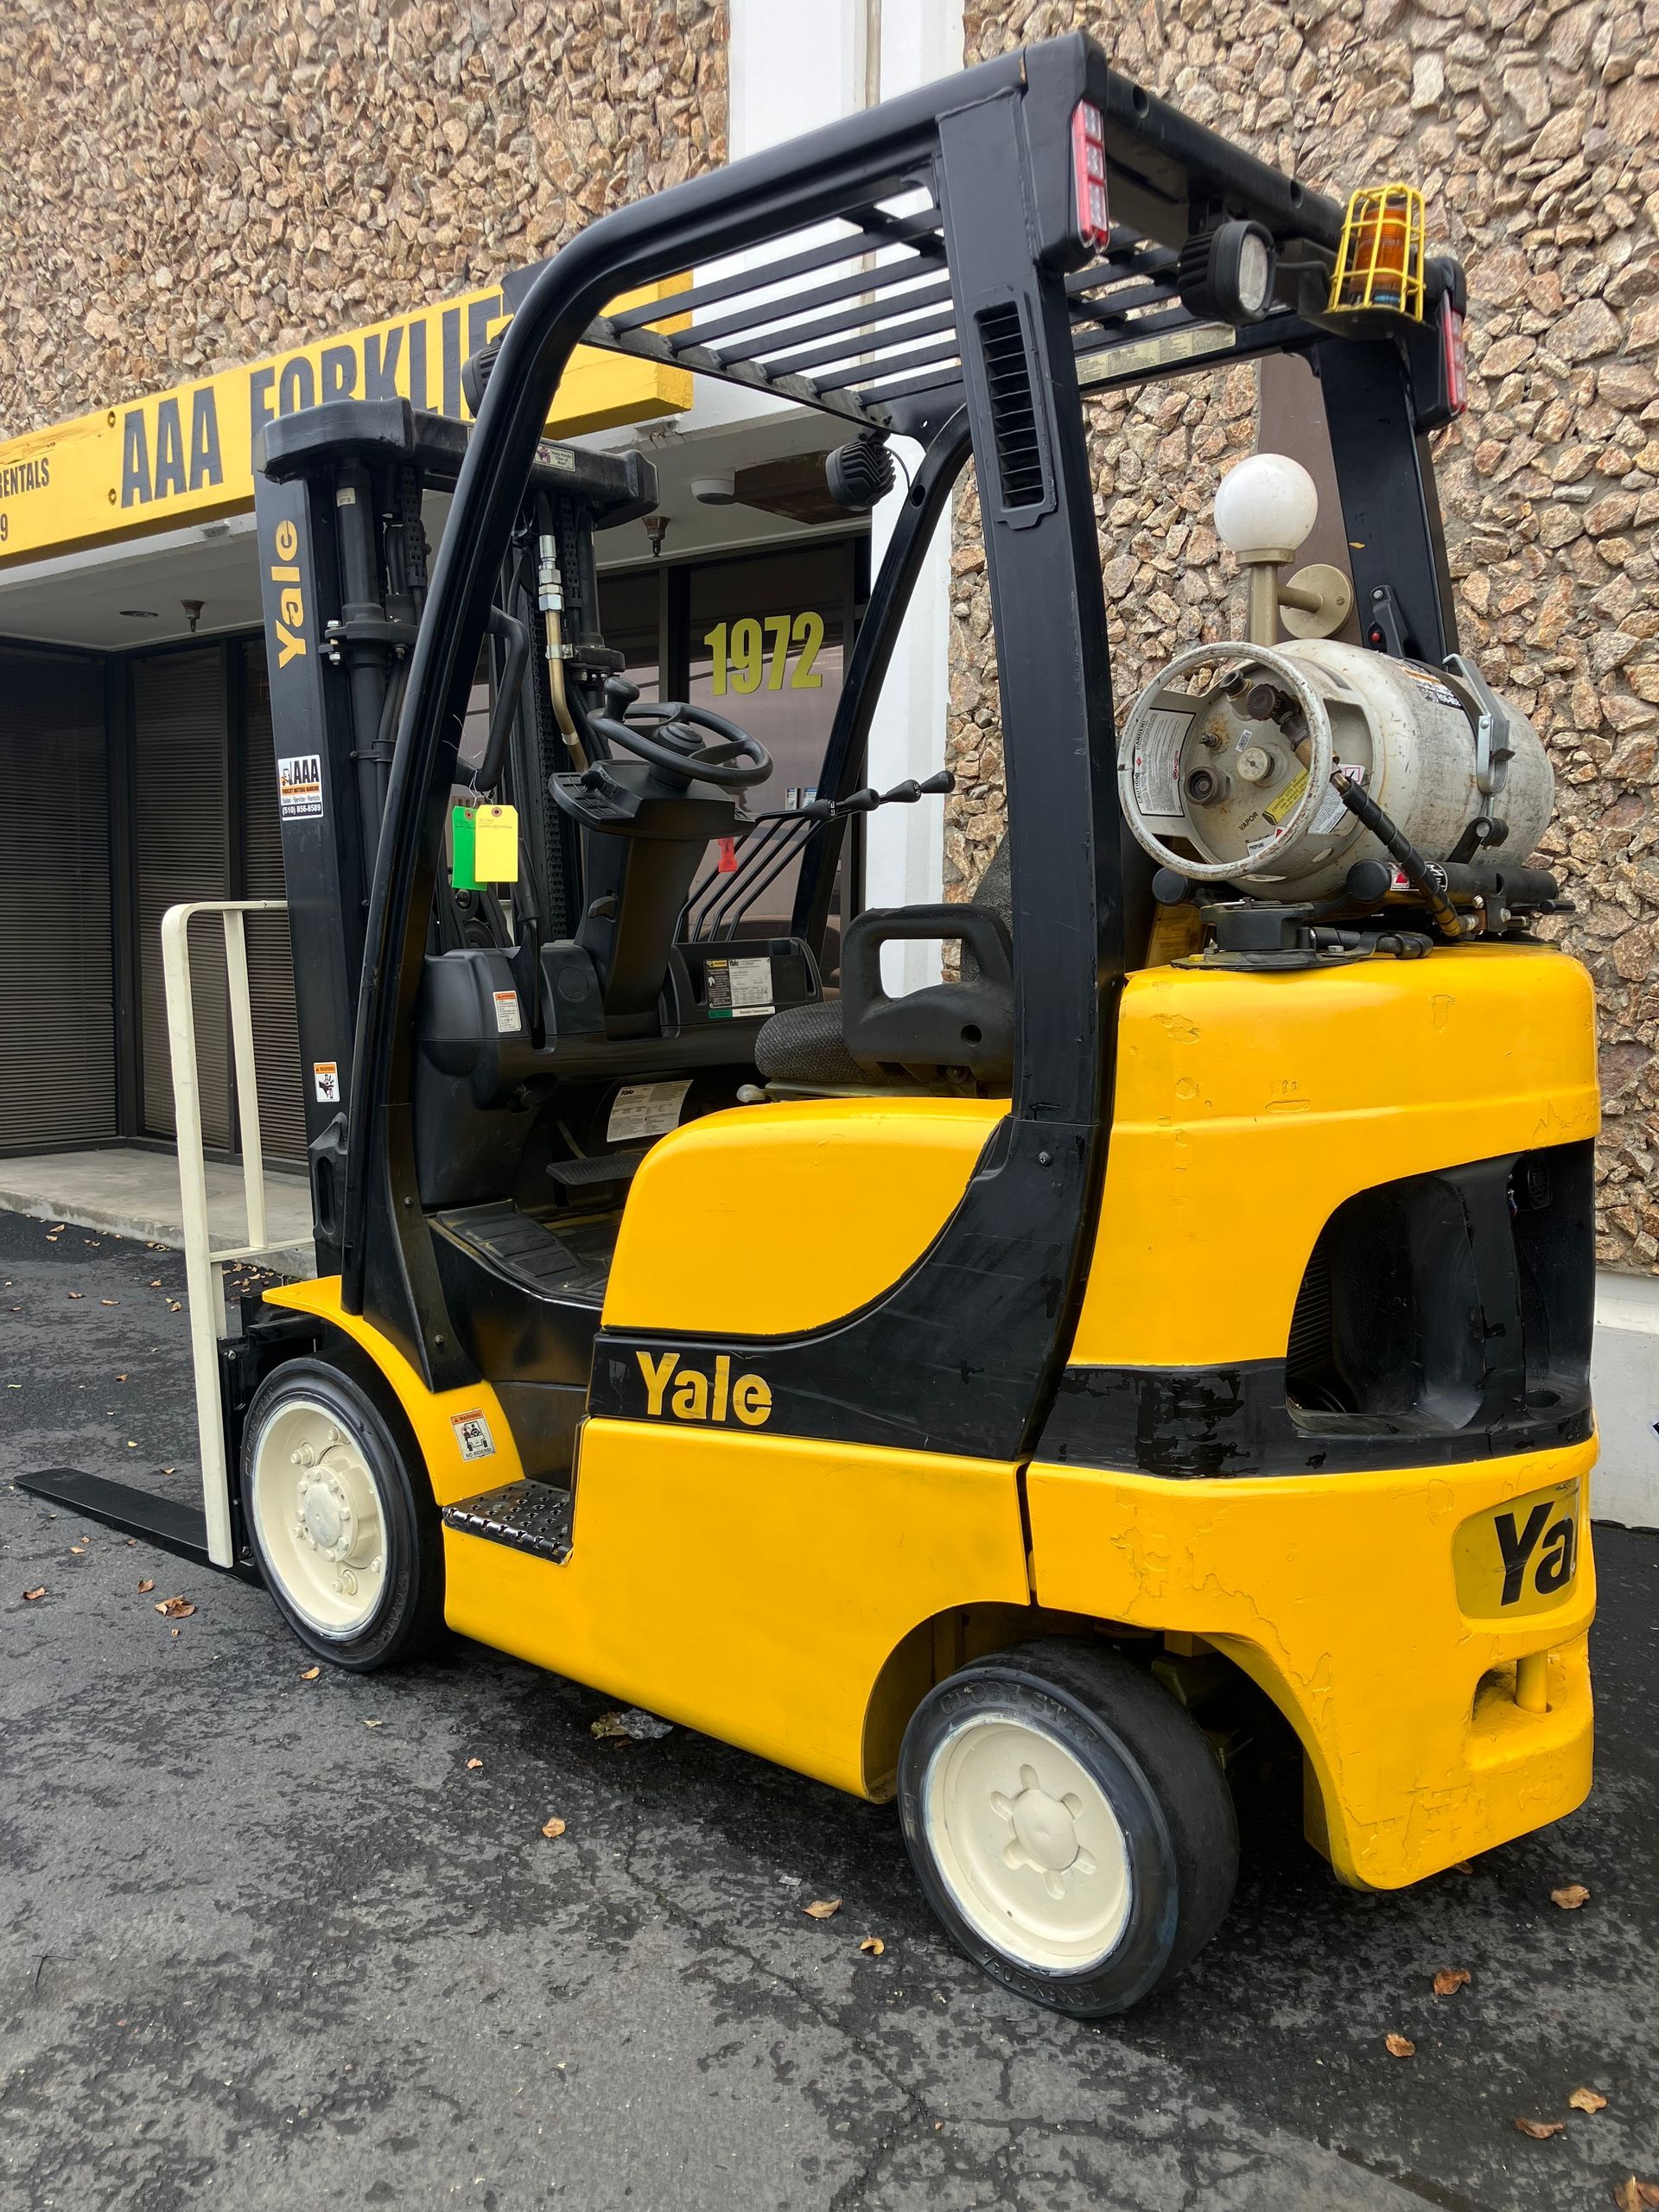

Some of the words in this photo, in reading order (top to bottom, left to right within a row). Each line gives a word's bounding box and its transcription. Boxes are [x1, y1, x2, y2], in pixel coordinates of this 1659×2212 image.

[121, 386, 224, 509] AAA
[270, 519, 307, 669] Yale
[704, 611, 824, 696] 1972
[293, 759, 320, 785] AAA
[282, 806, 296, 816] (510)
[1239, 811, 1259, 830] VAPOR
[636, 1351, 772, 1426] Yale
[460, 1412, 481, 1421] WARNING
